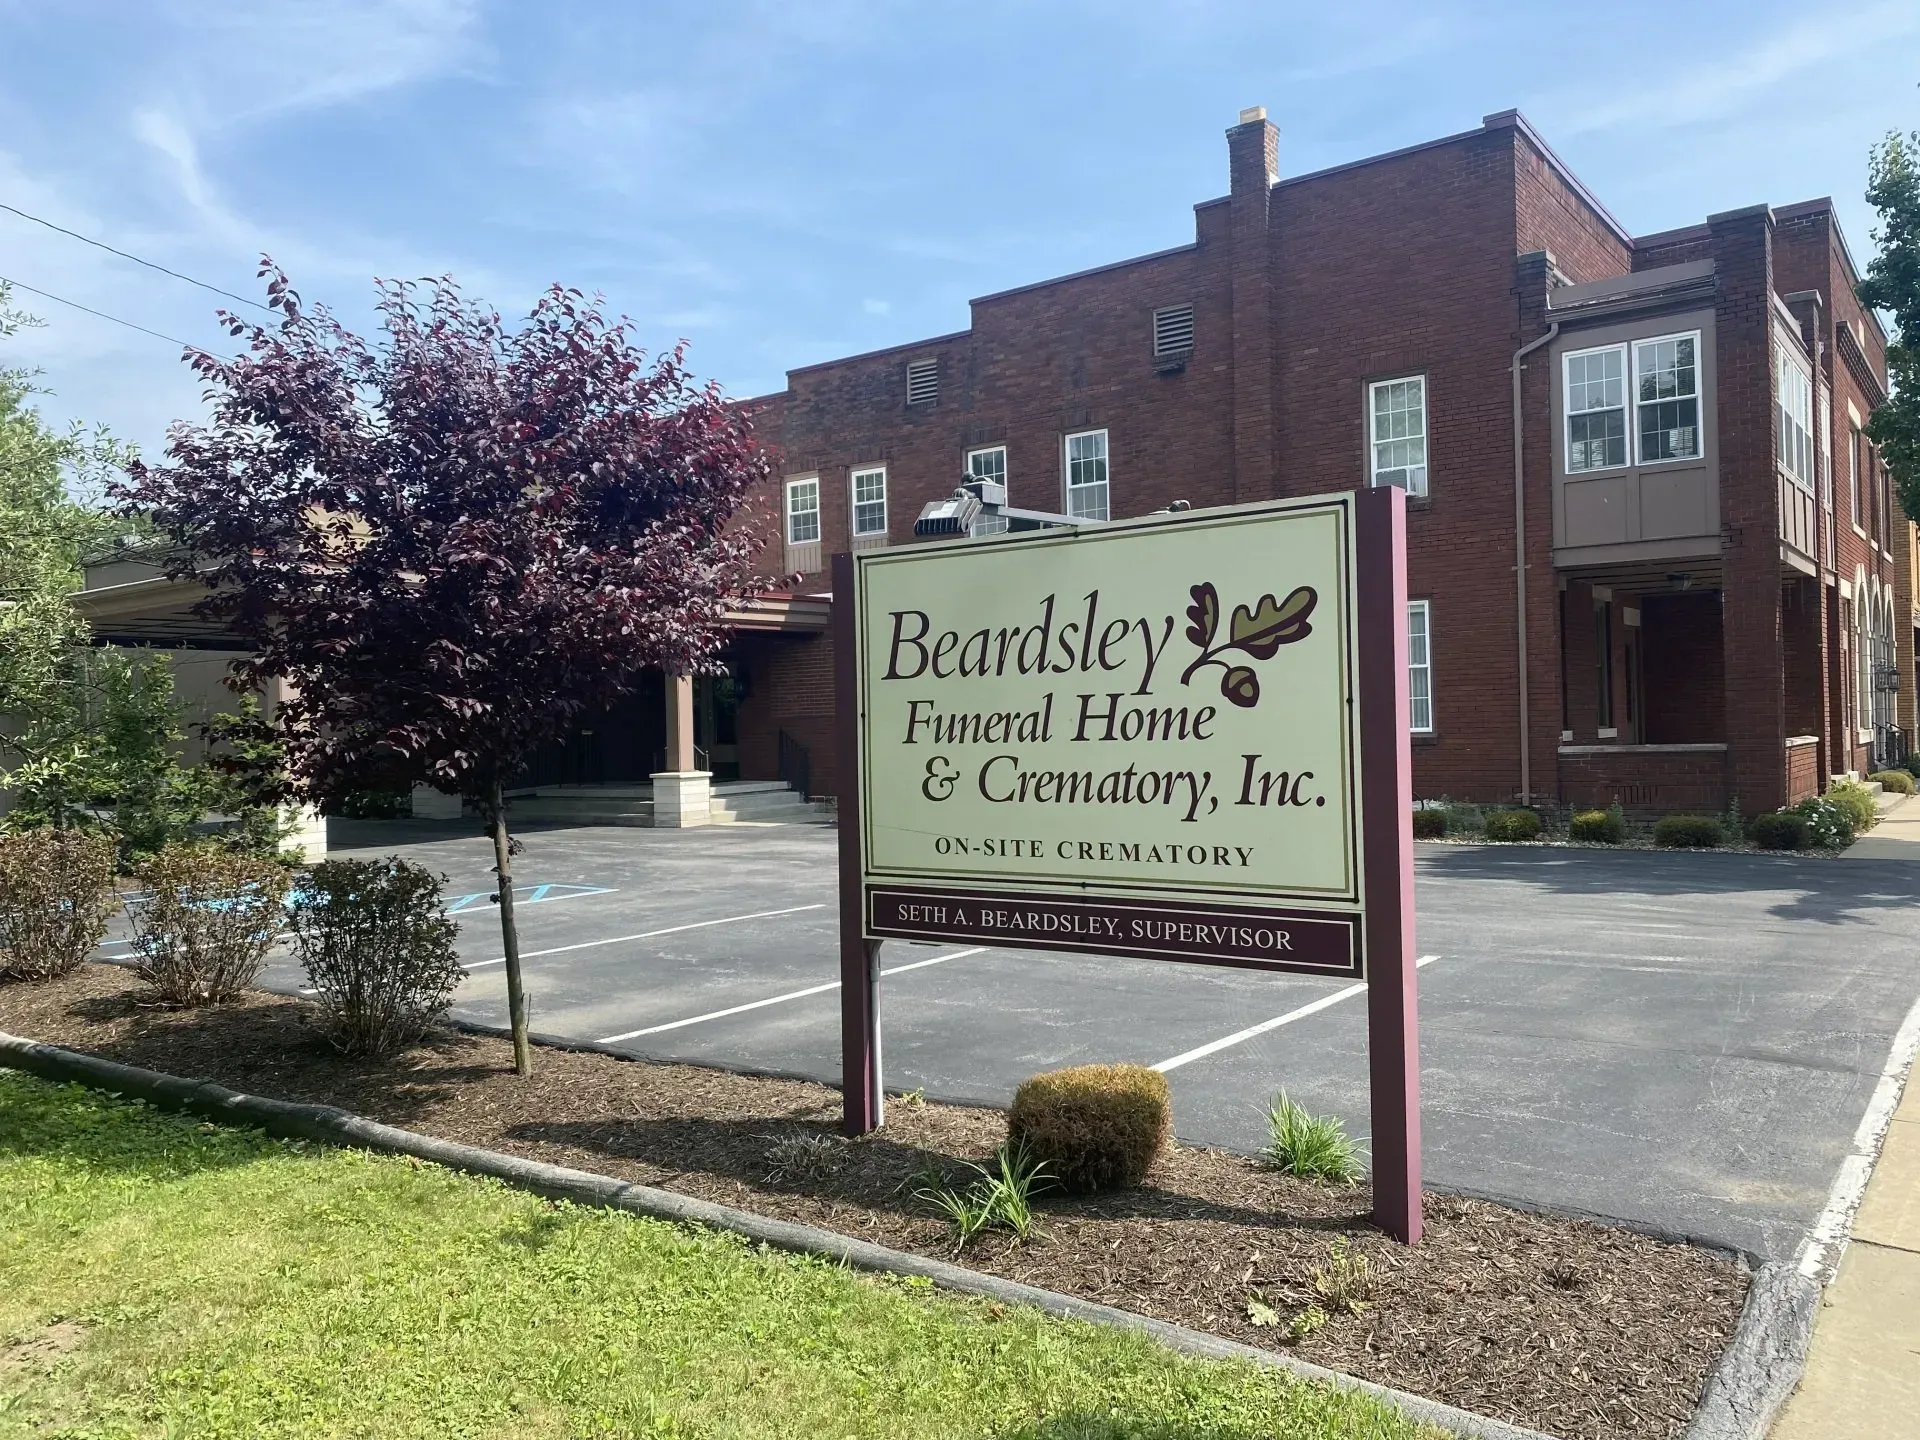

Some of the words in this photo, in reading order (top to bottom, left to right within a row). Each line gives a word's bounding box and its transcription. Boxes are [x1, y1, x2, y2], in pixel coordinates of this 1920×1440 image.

[881, 589, 1174, 696] Beardsley
[902, 693, 1053, 744] Funeral
[1070, 693, 1216, 742] Home
[922, 756, 960, 802] &
[978, 755, 1218, 822] Crematory,
[1235, 754, 1326, 807] Inc.
[935, 837, 1044, 859] ON-SITE
[1057, 841, 1254, 867] CREMATORY
[898, 904, 947, 925] SETH
[953, 908, 972, 926] A.
[980, 910, 1124, 939] BEARDSLEY,
[1131, 919, 1293, 951] SUPERVISOR
